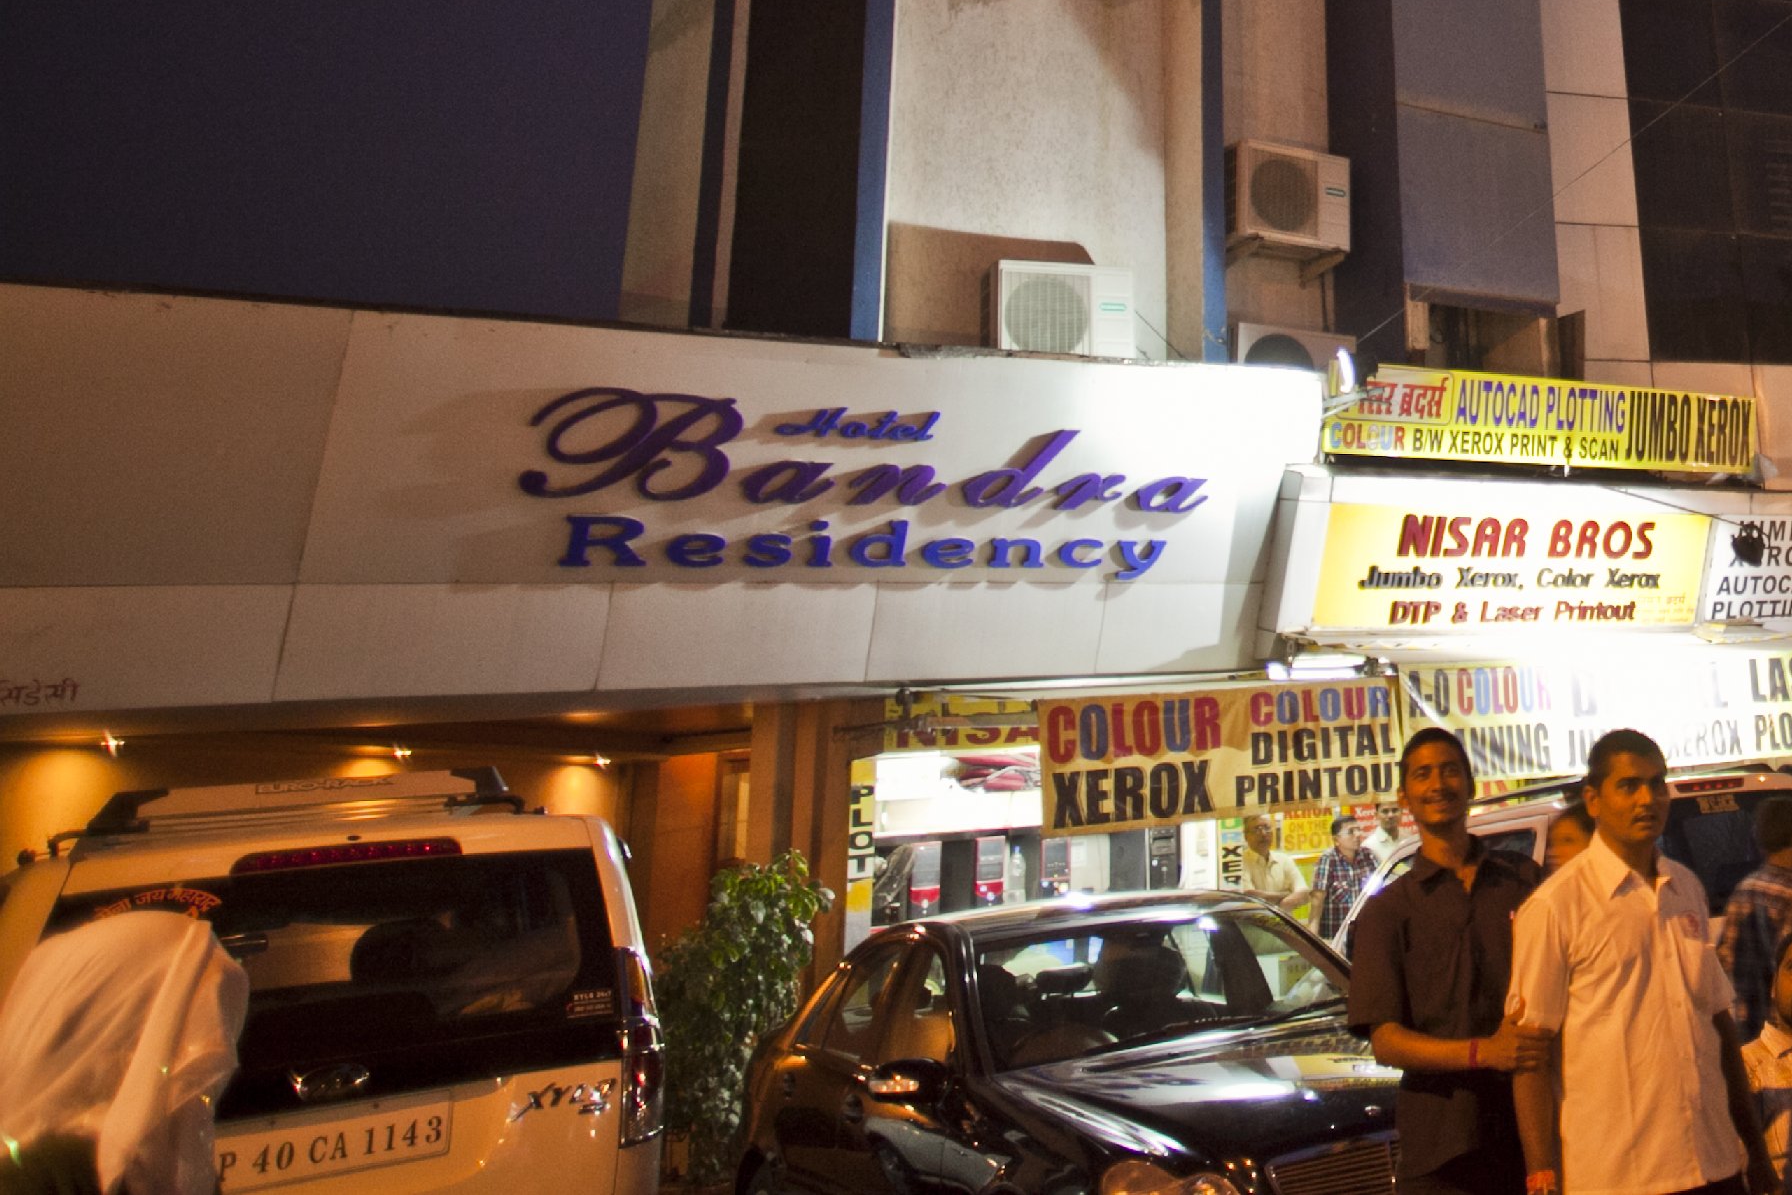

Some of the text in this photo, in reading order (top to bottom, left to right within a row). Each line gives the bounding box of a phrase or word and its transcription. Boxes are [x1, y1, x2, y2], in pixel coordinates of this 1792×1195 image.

[774, 408, 941, 442] Hotel
[1455, 379, 1626, 434] AUTOCAD PLOTTING
[1625, 389, 1752, 467] JUMBO XEROX
[518, 387, 1209, 514] Bandra
[1329, 422, 1620, 461] COLOUR B/W XEROX PRINT & SCAN
[557, 514, 1168, 581] Residency
[1396, 513, 1657, 560] NISAR BROS
[1358, 566, 1444, 591] Jumbo
[1536, 568, 1595, 589] Color
[1604, 569, 1661, 591] Xerox
[1389, 600, 1442, 625] DTP
[1452, 602, 1468, 624] &
[1480, 601, 1543, 623] Laser
[1554, 600, 1637, 623] Printout
[1250, 686, 1390, 727] COLOUR
[1457, 665, 1552, 717] COLOUR
[1046, 696, 1223, 765] COLOUR
[1251, 723, 1396, 767] DIGITAL
[1052, 760, 1214, 830] XEROX
[252, 1142, 295, 1175] 40
[308, 1132, 348, 1164] CA
[364, 1115, 444, 1156] 1143
